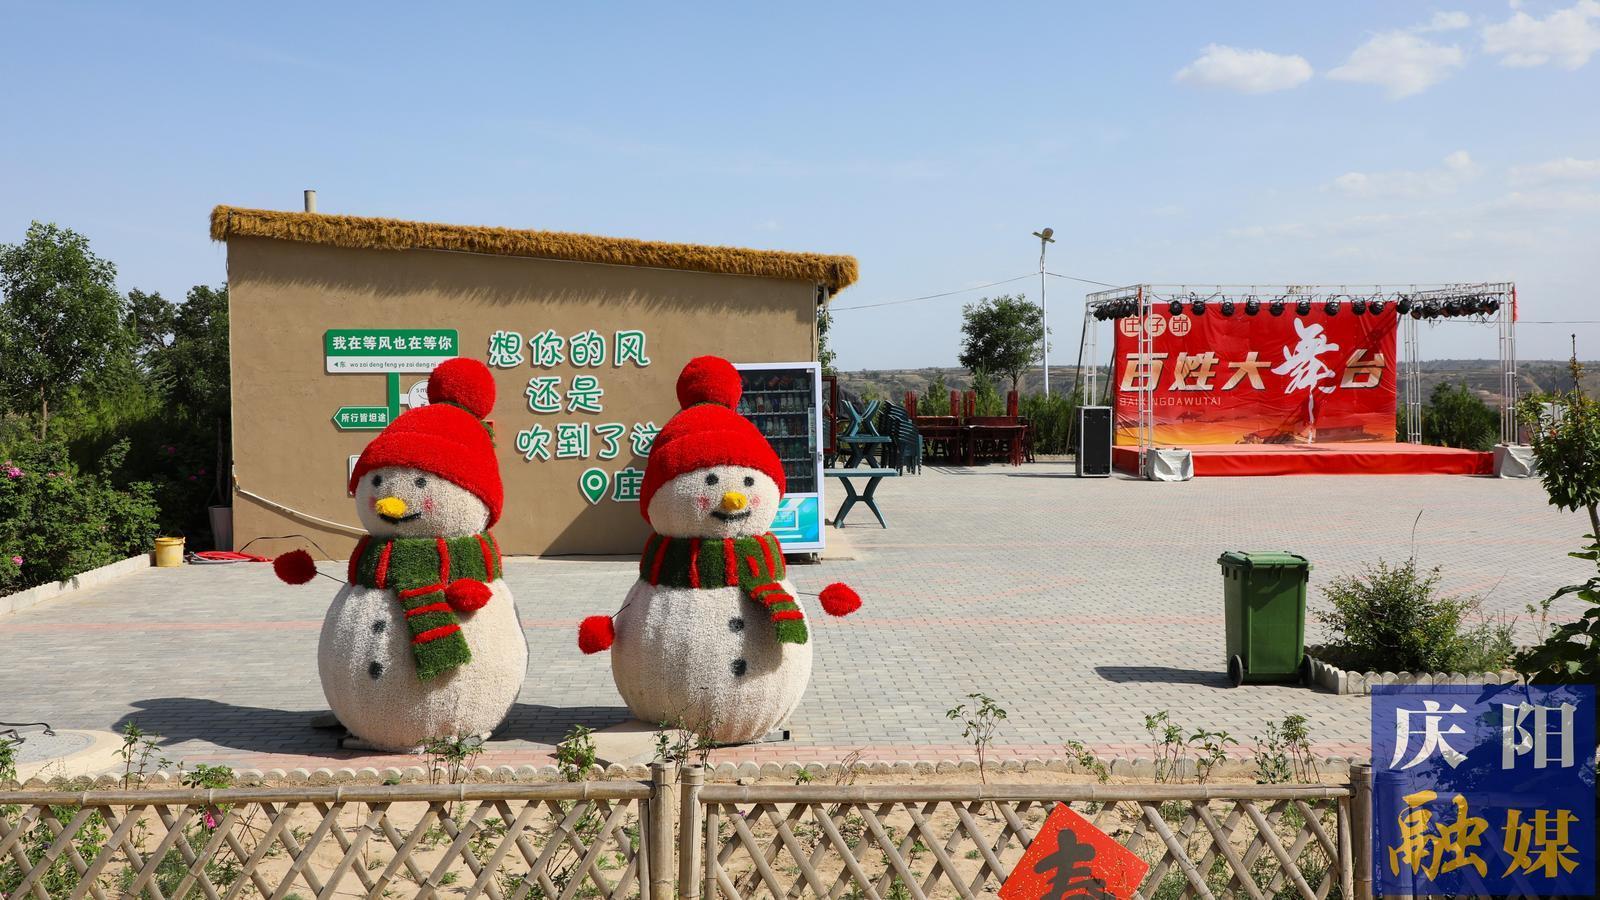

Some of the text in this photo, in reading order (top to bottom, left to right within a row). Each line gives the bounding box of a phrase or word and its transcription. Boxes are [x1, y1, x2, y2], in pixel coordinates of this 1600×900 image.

[332, 335, 453, 350] 我在等风也在等你
[489, 329, 650, 367] 想你的风
[369, 361, 384, 369] deng
[384, 361, 397, 369] feng
[415, 361, 430, 369] deng
[1120, 317, 1385, 422] 百姓大舞台
[527, 375, 604, 413] 还是
[1119, 397, 1221, 406] BAIXNGDAWUTAI
[341, 412, 387, 423] 所行皆坦途
[517, 421, 662, 461] 吹到了这
